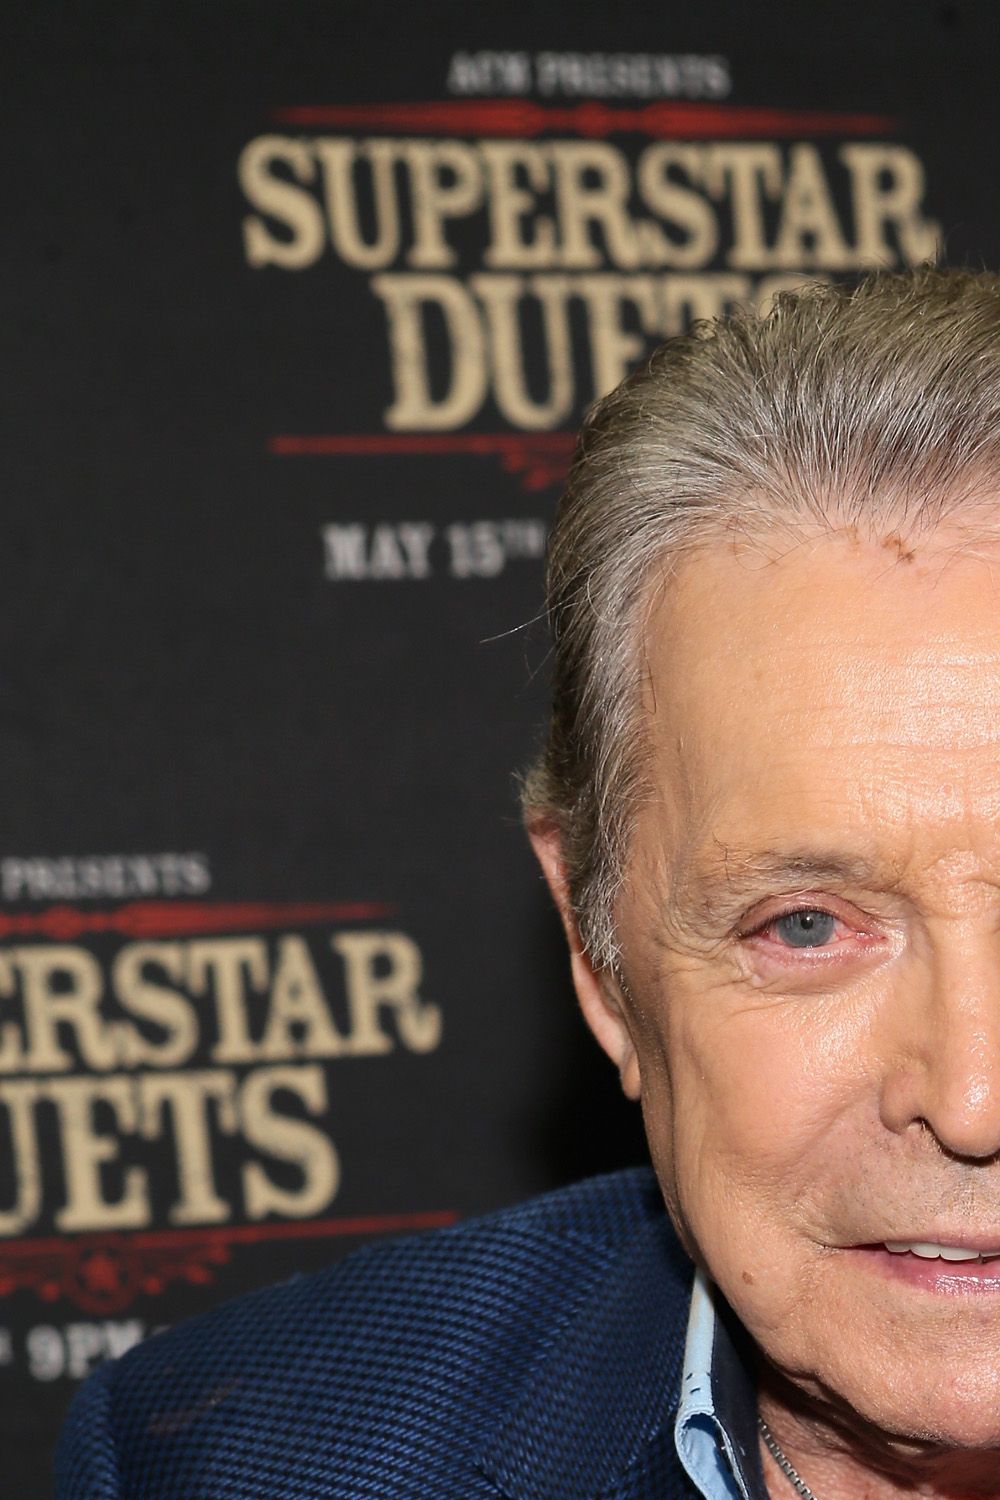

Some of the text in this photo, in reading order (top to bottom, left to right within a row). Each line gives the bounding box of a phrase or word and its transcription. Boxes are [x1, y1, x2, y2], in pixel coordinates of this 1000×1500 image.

[536, 52, 731, 99] PRESENTS
[238, 134, 941, 270] SUPERSTAR
[370, 271, 815, 432] DUET
[323, 521, 434, 580] MAY
[0, 930, 442, 1072] RSTAR
